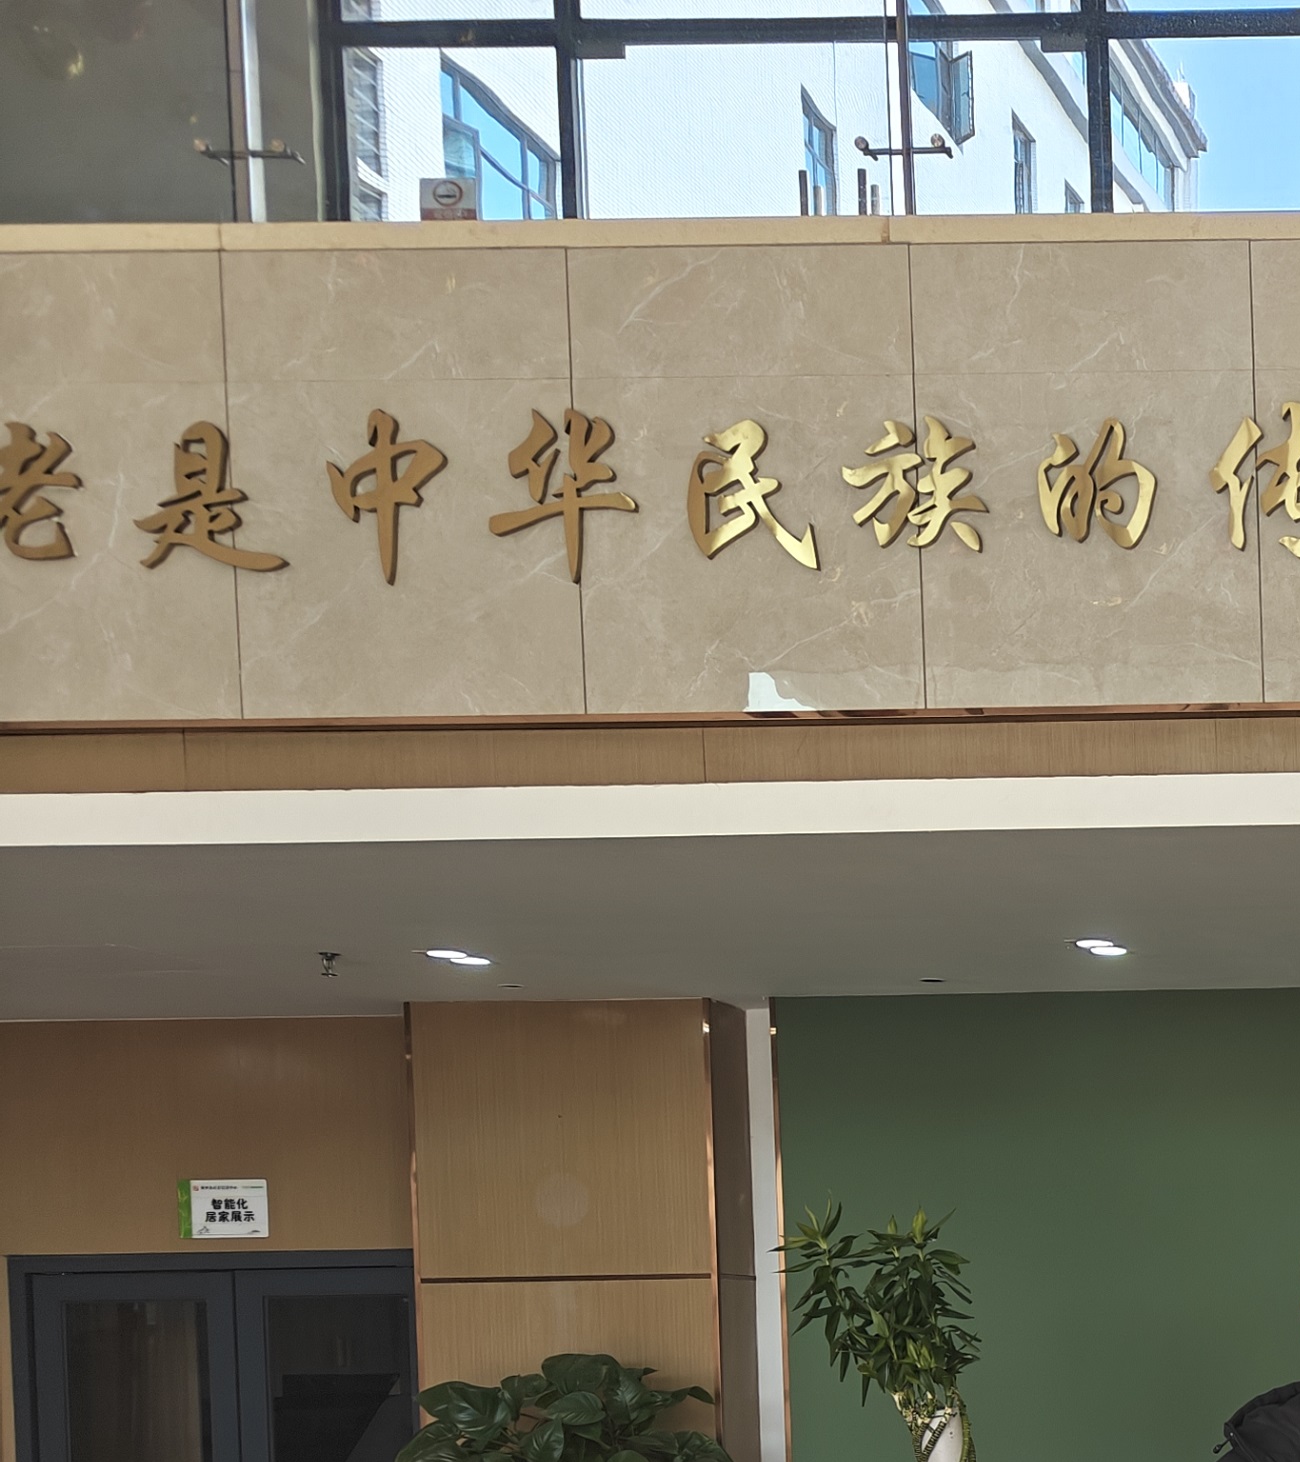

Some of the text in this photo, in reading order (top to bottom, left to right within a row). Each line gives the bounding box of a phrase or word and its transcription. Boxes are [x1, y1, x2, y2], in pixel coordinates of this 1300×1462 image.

[212, 1199, 248, 1209] 智能化
[205, 1211, 255, 1222] 居家展示
